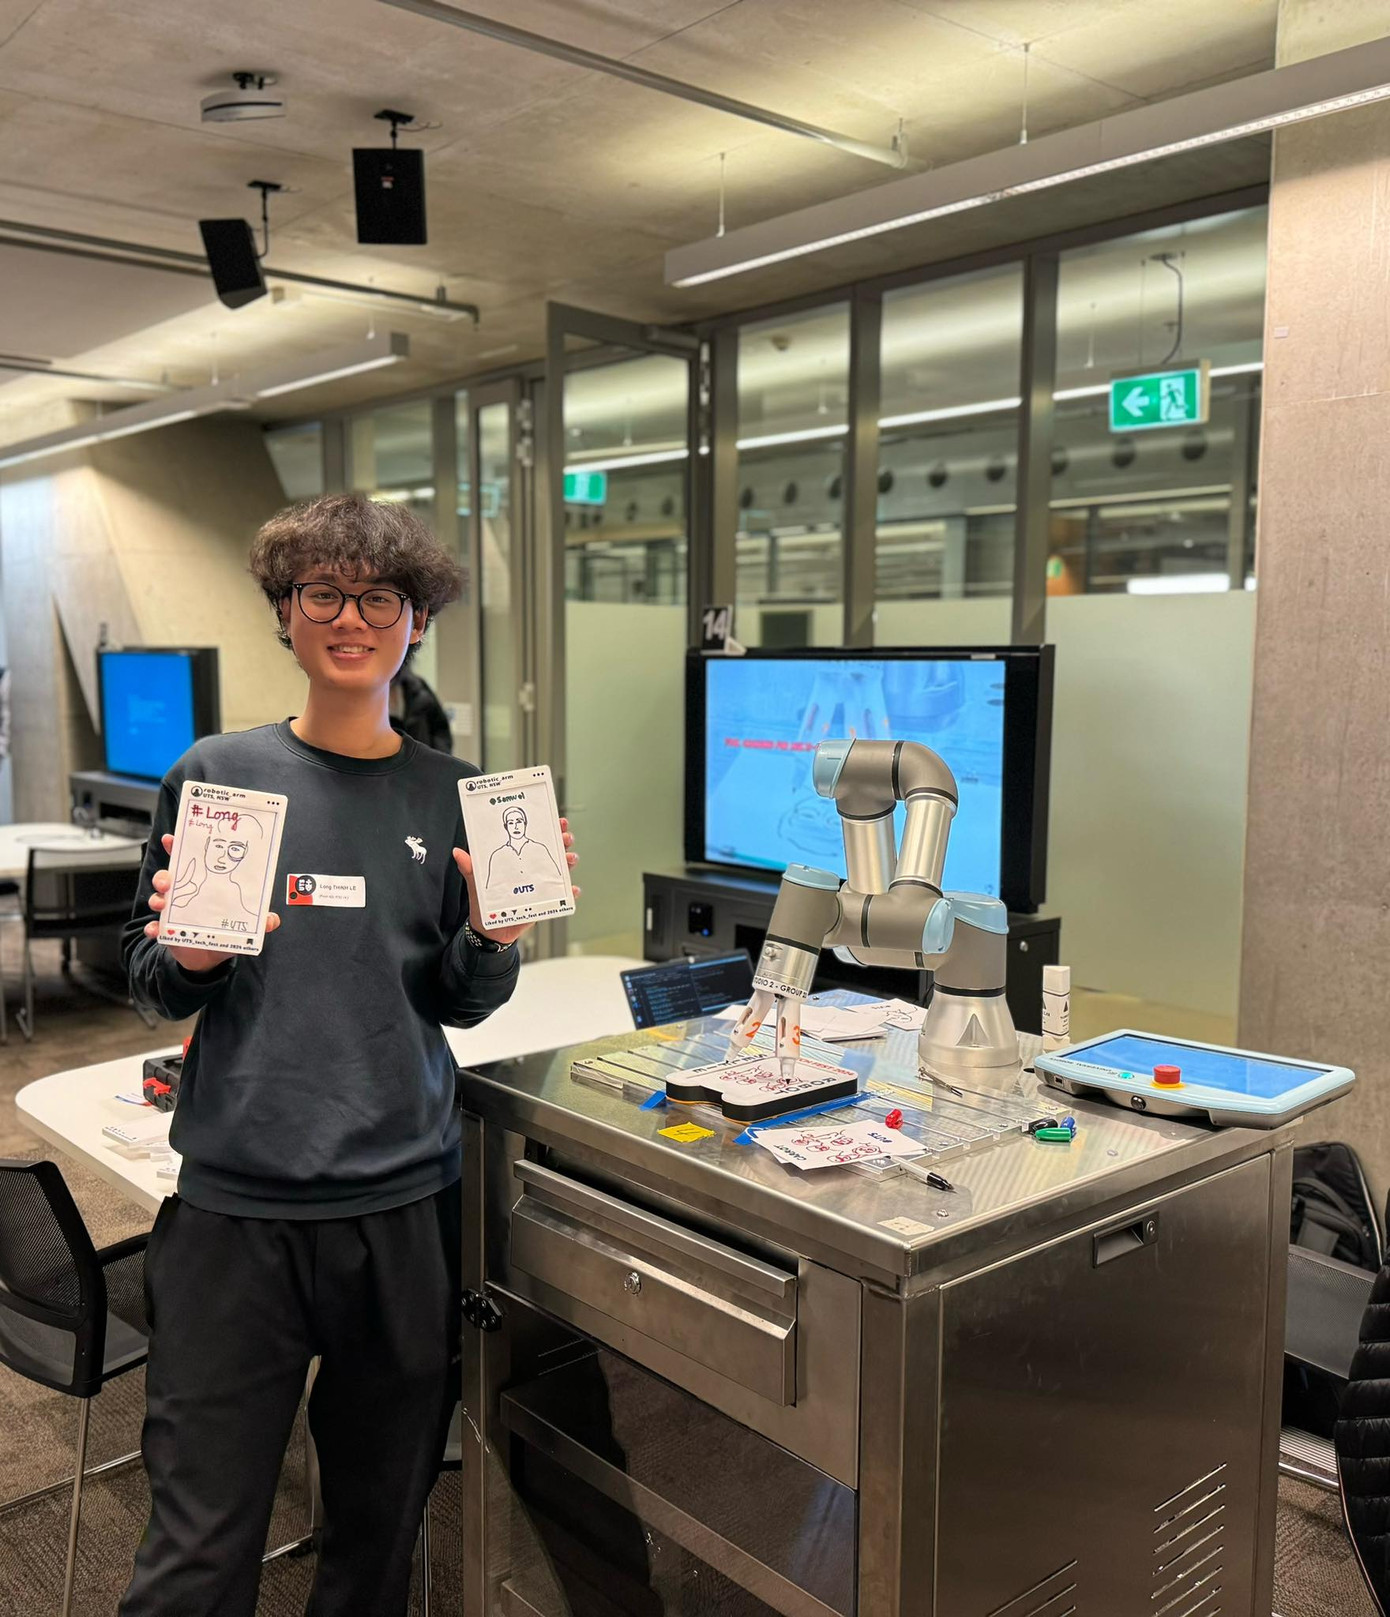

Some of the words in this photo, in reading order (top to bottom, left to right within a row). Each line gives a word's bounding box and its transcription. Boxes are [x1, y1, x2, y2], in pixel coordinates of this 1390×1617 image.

[703, 609, 727, 640] 14
[476, 774, 514, 785] robotic_arm
[203, 788, 246, 799] robotic_arm
[221, 918, 248, 932] #UTS
[780, 984, 803, 997] GROUP
[745, 1021, 761, 1038] 2
[792, 1025, 801, 1045] 3
[774, 1077, 837, 1094] ROBOT
